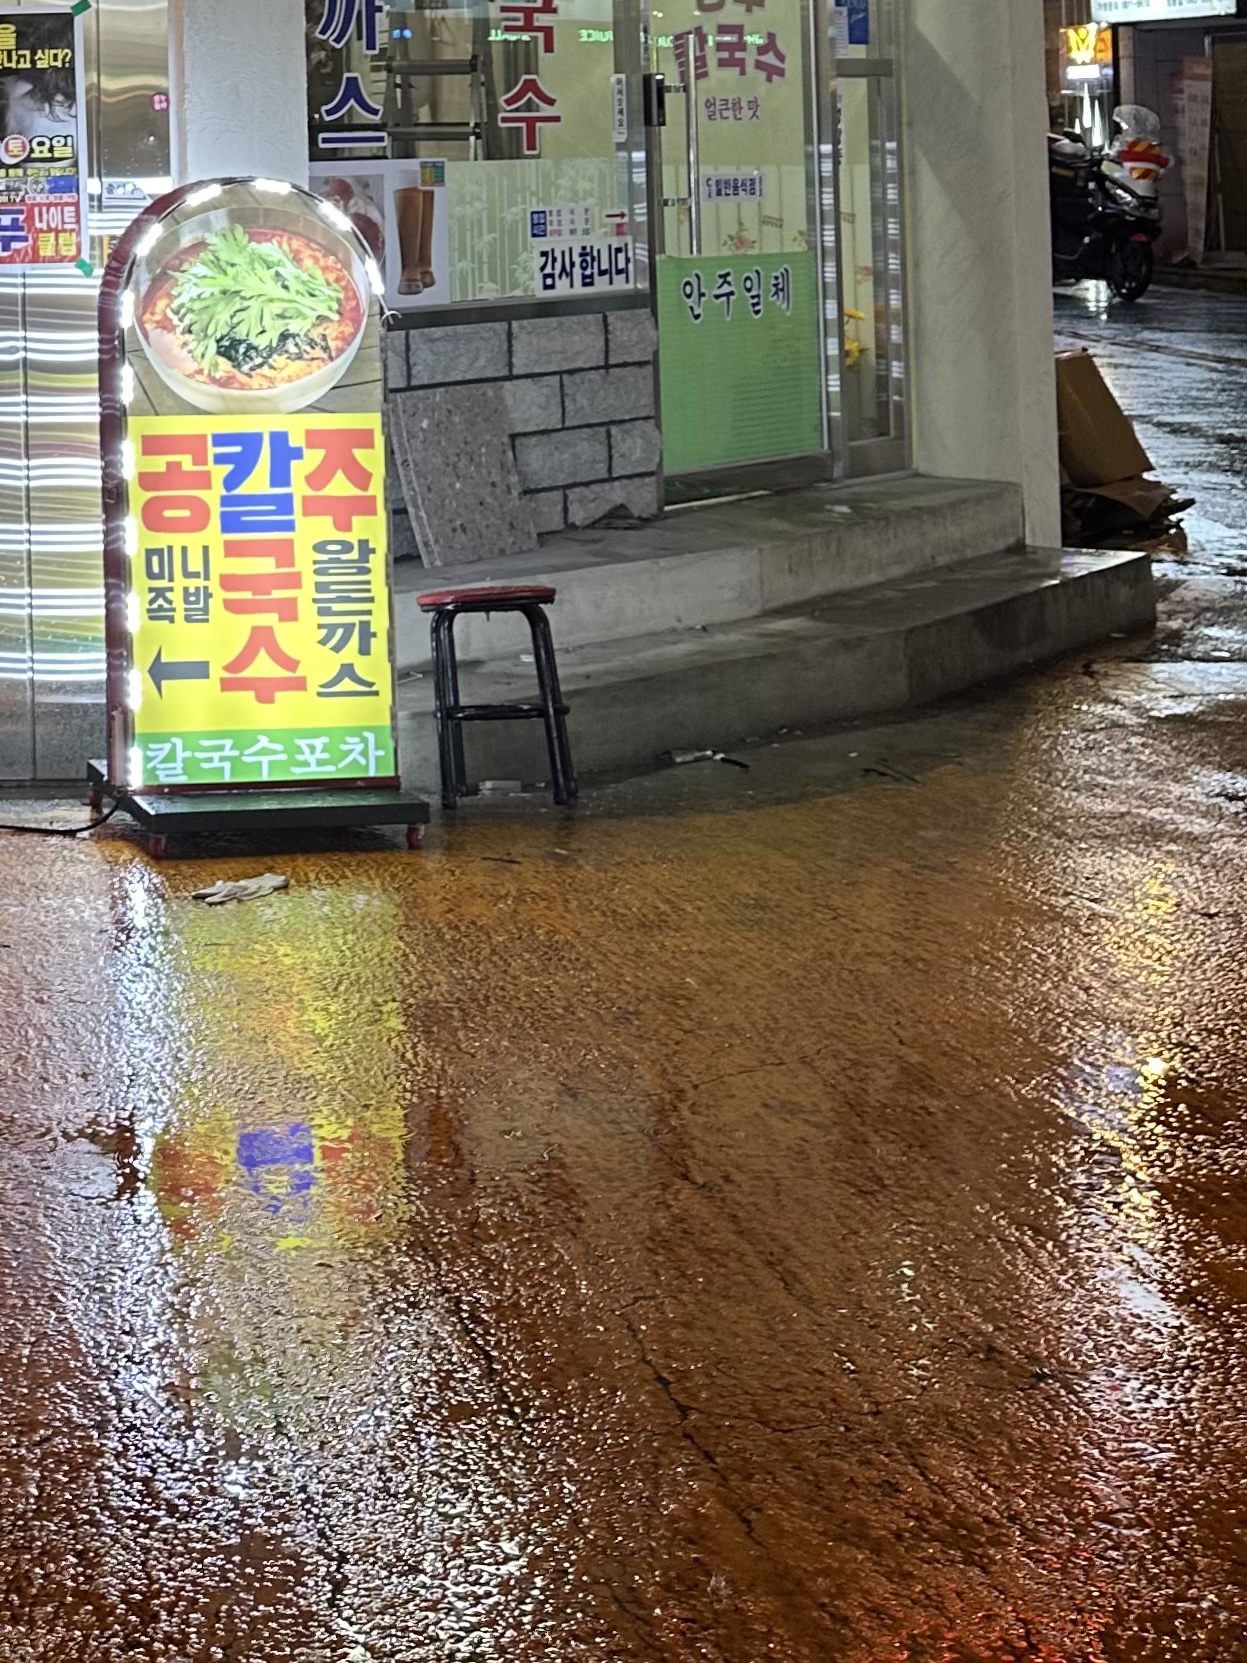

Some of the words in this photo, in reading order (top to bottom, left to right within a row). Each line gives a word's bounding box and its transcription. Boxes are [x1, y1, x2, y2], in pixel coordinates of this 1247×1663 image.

[34, 49, 72, 68] 싶다?
[674, 24, 786, 84] 칼국수
[705, 97, 743, 121] 얼큰한
[747, 96, 760, 120] 맛
[30, 136, 74, 159] 요일
[34, 207, 78, 230] 나이트
[539, 242, 631, 290] 감사합니다
[682, 267, 792, 323] 안주일체
[145, 544, 212, 582] 미니
[147, 585, 213, 624] 족발
[311, 539, 380, 698] 왕돈까스
[147, 731, 385, 782] 칼국수포차
